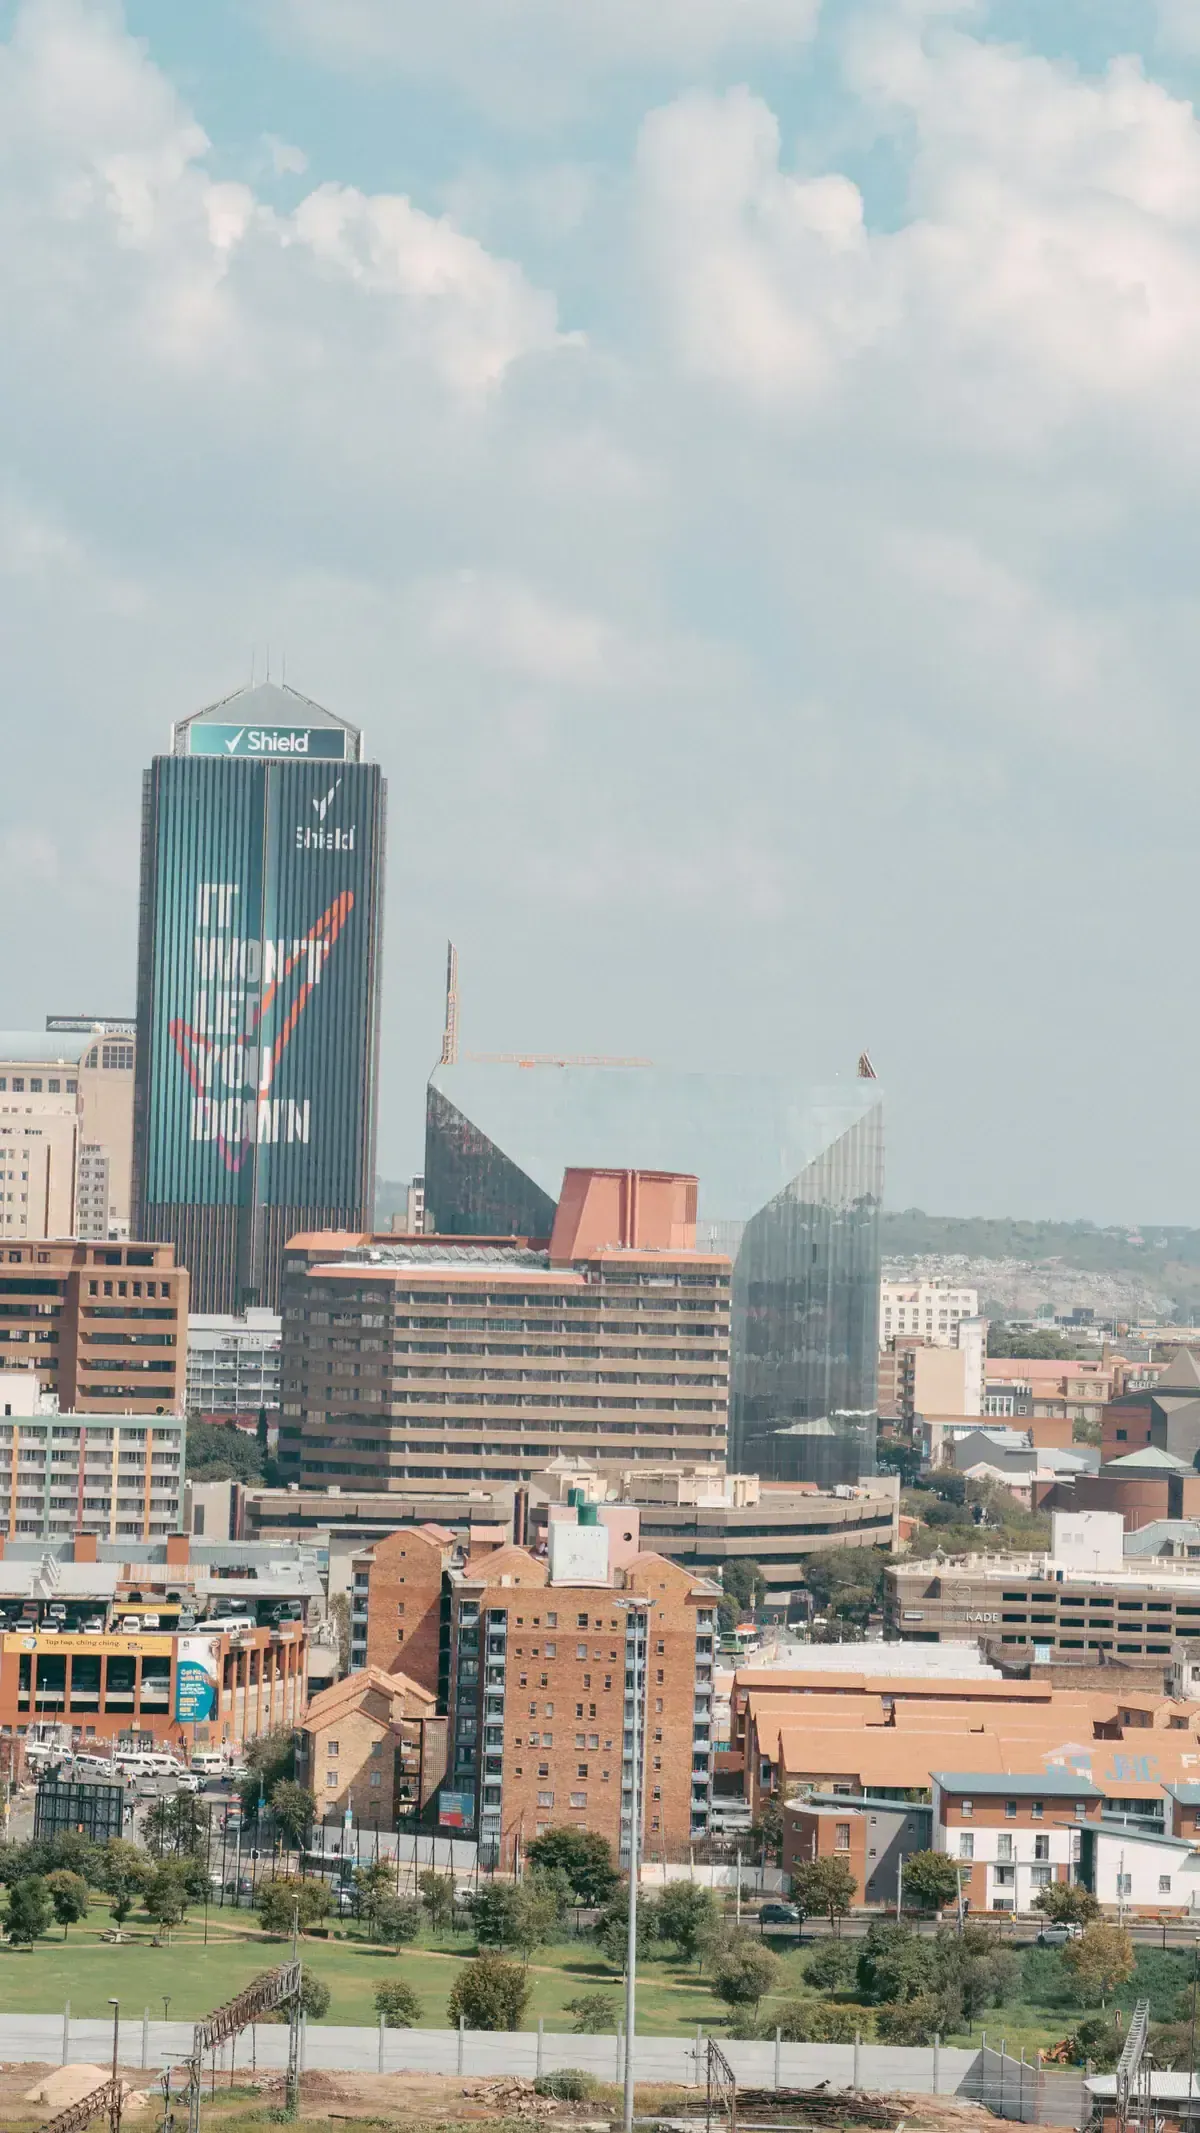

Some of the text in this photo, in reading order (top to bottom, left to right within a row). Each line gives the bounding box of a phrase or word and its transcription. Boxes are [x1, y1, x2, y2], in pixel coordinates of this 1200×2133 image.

[247, 731, 309, 753] Shield
[296, 826, 354, 850] Shield
[198, 883, 239, 928] IT
[193, 991, 260, 1036] LET
[191, 1043, 272, 1090] YOU
[190, 1097, 310, 1143] DOWN
